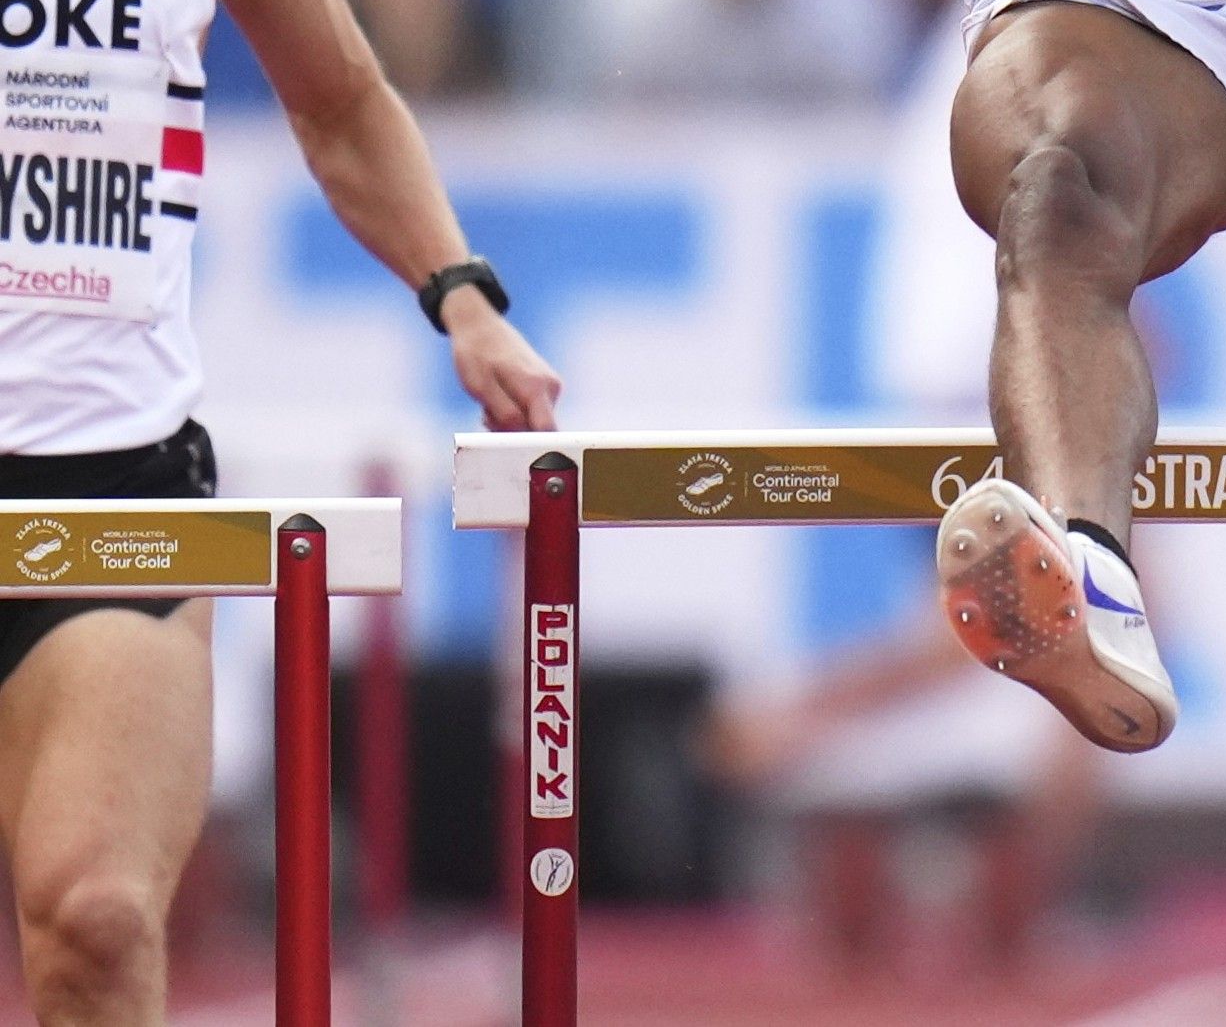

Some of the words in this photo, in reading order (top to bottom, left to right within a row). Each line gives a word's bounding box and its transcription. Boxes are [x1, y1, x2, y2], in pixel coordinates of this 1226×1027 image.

[5, 67, 90, 89] NÁRODNÍ
[5, 116, 103, 134] AGENTURA
[753, 473, 840, 488] Continental
[678, 494, 710, 515] GOLDEN
[761, 488, 793, 503] Tour
[796, 488, 832, 503] Gold
[91, 539, 178, 554] Continental
[99, 554, 132, 570] Tour
[134, 553, 171, 569] Gold
[16, 561, 48, 581] GOLDEN
[534, 610, 571, 800] POLANIK
